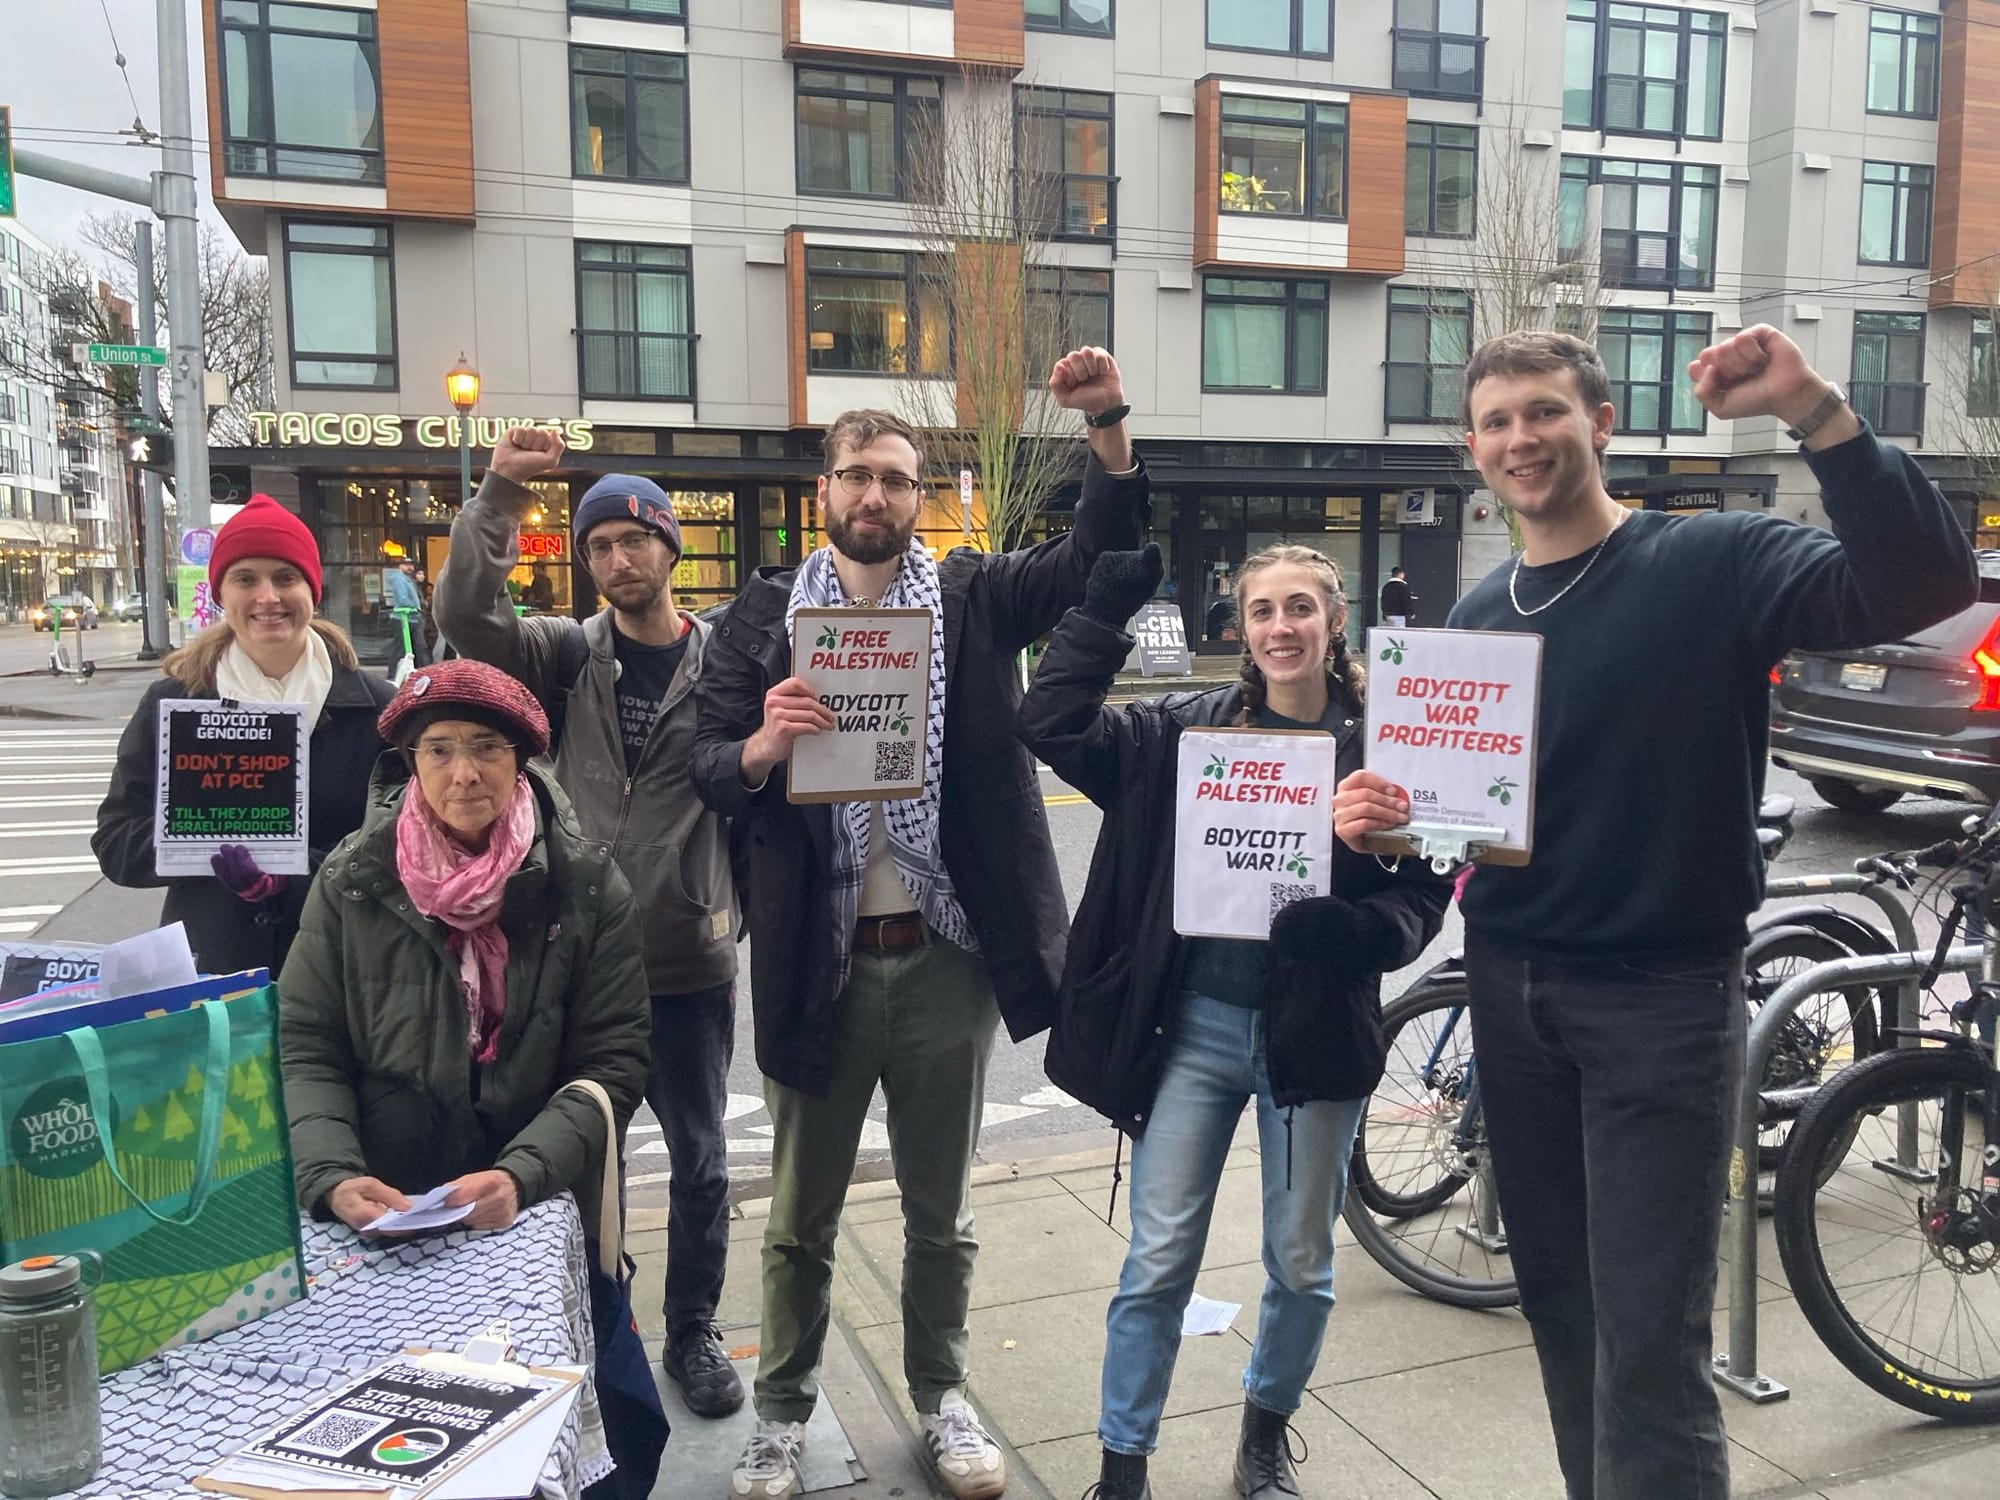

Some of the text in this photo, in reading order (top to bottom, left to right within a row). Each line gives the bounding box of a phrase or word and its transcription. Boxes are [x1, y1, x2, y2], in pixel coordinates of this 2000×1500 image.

[90, 347, 152, 362] E Union St
[249, 412, 402, 446] TACOS
[1674, 493, 1717, 506] CENTRAL
[519, 536, 562, 555] PEN
[1147, 616, 1184, 631] CEN
[841, 630, 891, 648] FREE
[1136, 632, 1184, 647] TRAL
[810, 652, 919, 670] PALESTINE!
[1396, 677, 1511, 703] BOYCOTT
[819, 694, 909, 712] BOYCOTT
[201, 714, 268, 726] BOYCOTT
[1425, 703, 1479, 726] WAR
[197, 727, 272, 740] GENOCIDE!
[1377, 724, 1524, 755] PROFITEERS
[176, 754, 290, 771] DON'T SHOP
[1229, 761, 1286, 781] FREE
[201, 773, 264, 788] AT PCC
[1196, 782, 1318, 805] PALESTINE!
[1413, 789, 1438, 801] DSA
[175, 808, 290, 819] TILL THEY DROP
[172, 821, 293, 832] ISRAELI PRODUCTS
[1204, 828, 1307, 850] BOYCOTT
[45, 961, 100, 979] BOYC
[22, 1103, 94, 1135] WHOL
[29, 1122, 99, 1154] FOOD
[380, 1372, 414, 1384] TELL
[390, 1366, 427, 1377] SIGN
[426, 1371, 454, 1383] OUR
[1883, 1363, 1972, 1402] MAXXIS
[339, 1398, 418, 1417] ISRAEL'S
[407, 1398, 493, 1420] FUNDING
